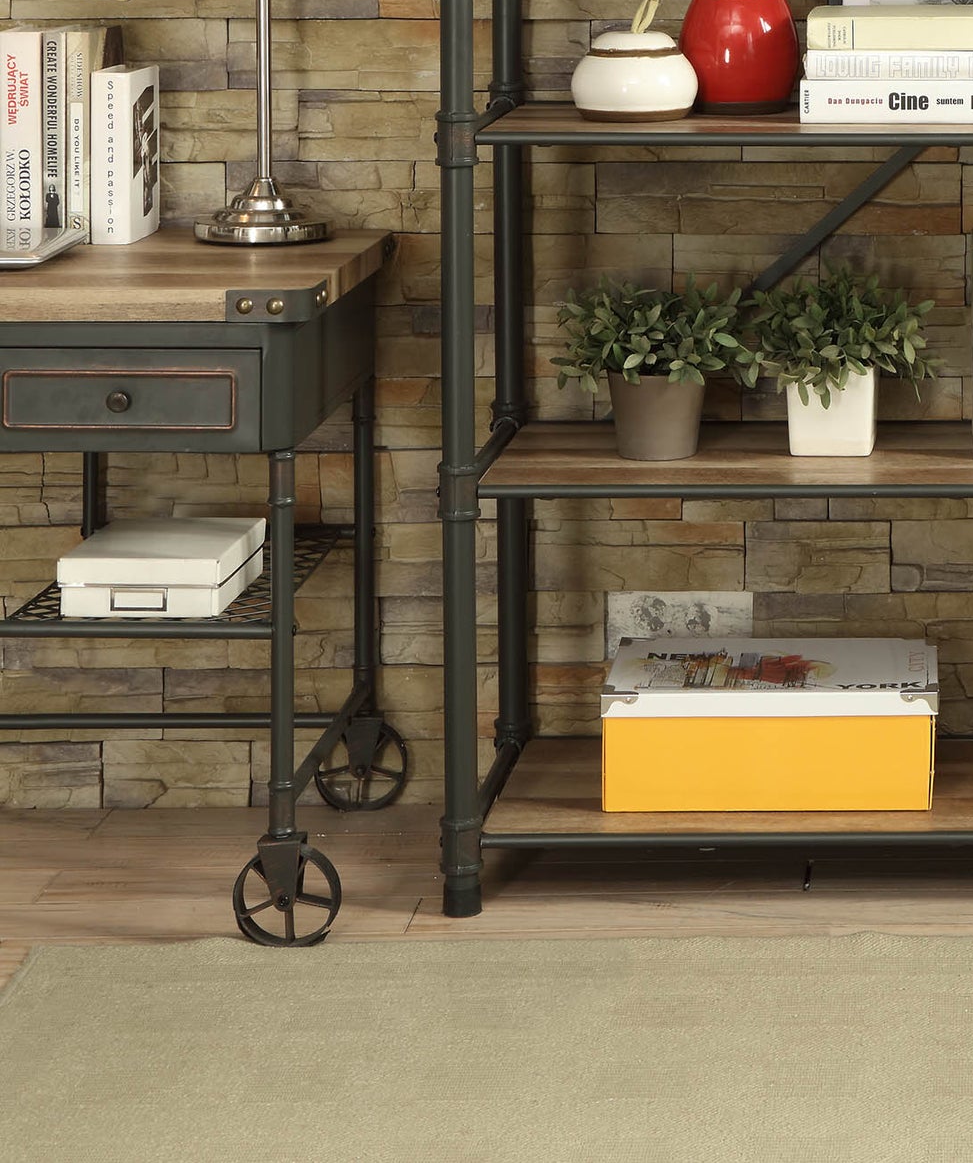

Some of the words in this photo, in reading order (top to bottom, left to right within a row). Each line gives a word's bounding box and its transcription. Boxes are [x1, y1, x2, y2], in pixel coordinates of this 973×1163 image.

[46, 40, 57, 73] CREATE
[18, 71, 29, 107] ŚWIAT
[46, 75, 58, 131] WONDERFUL
[827, 97, 843, 105] Dan
[888, 92, 929, 110] Cine
[936, 97, 964, 105] suntem
[74, 118, 80, 132] DO
[47, 134, 58, 178] HOMELIFE
[6, 163, 16, 222] GRZEGORZ
[18, 149, 31, 220] KOŁODKO
[74, 179, 80, 189] IT
[837, 681, 921, 689] YORK
